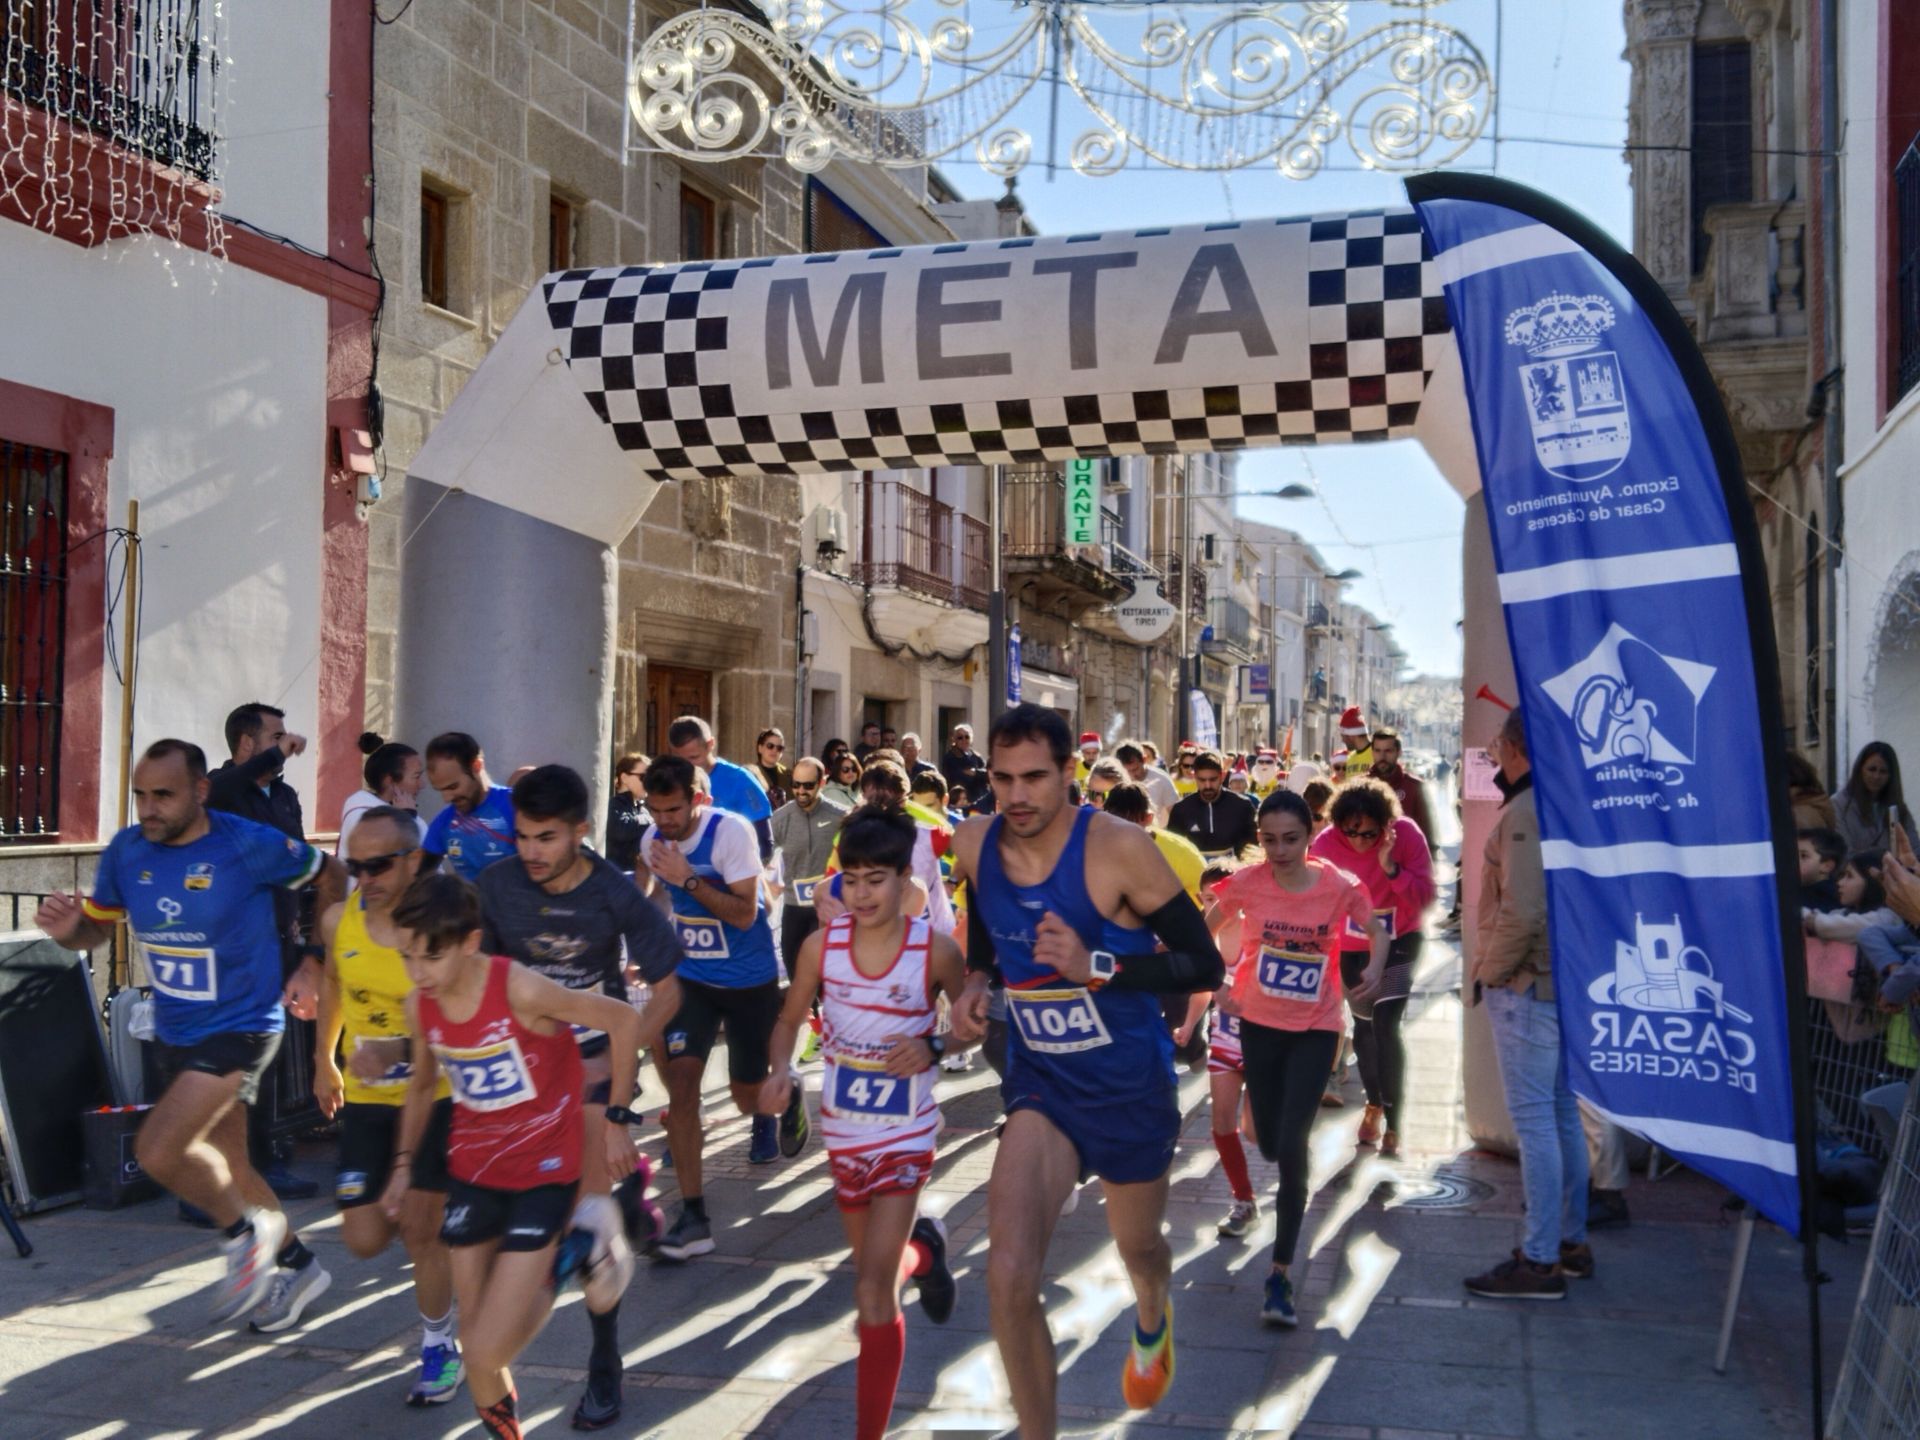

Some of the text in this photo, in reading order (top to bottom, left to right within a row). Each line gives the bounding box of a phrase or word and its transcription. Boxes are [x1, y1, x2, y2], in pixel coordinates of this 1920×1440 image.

[765, 243, 1278, 389] META
[1121, 607, 1170, 617] RESTAURANTE
[683, 928, 714, 948] 90
[155, 959, 194, 986] 71
[1265, 961, 1320, 990] 120
[1021, 1006, 1094, 1036] 104
[847, 1077, 897, 1108] 47
